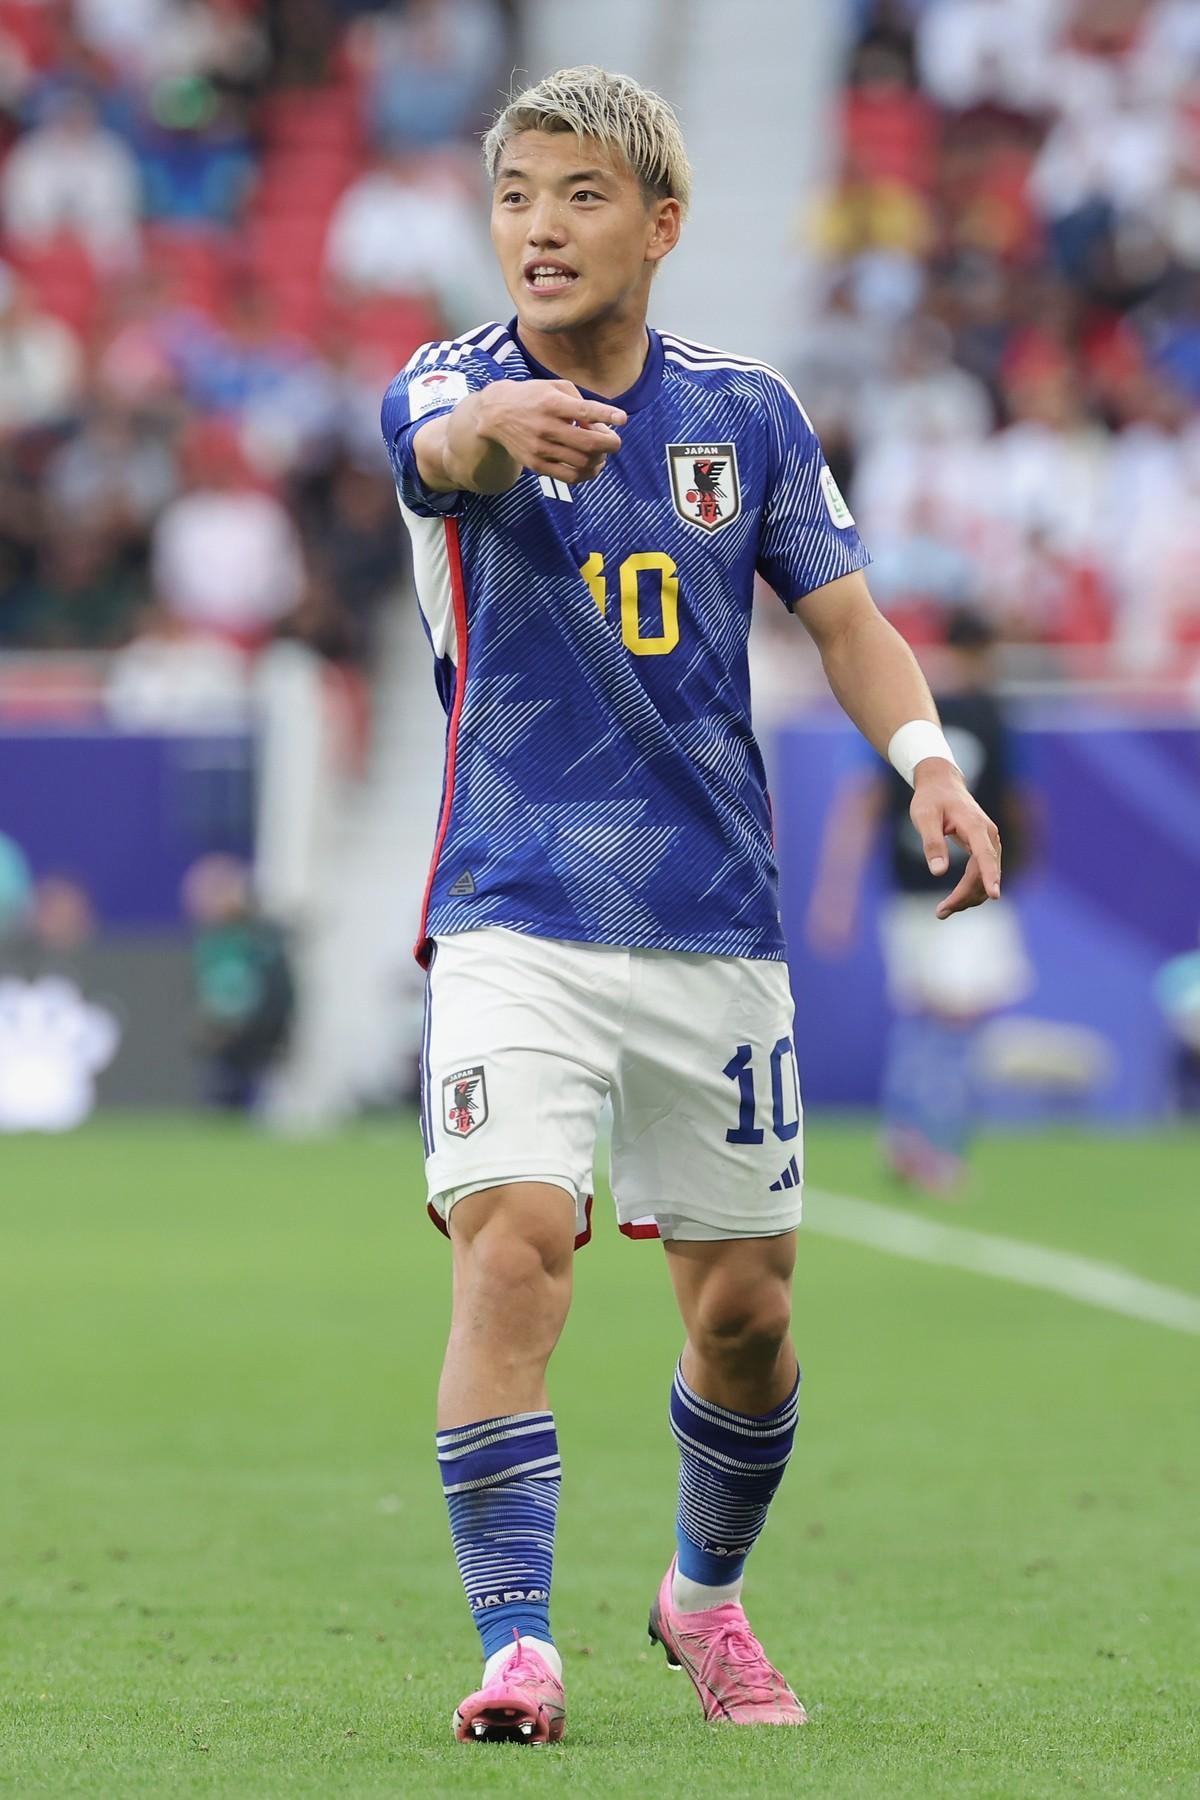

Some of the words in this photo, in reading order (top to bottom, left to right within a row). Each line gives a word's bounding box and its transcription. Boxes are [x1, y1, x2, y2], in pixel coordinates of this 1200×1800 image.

[684, 447, 719, 455] JAPAN
[694, 503, 723, 517] JFA
[449, 1069, 474, 1082] JAPAN
[722, 1036, 799, 1145] 10
[454, 1114, 476, 1130] JFA
